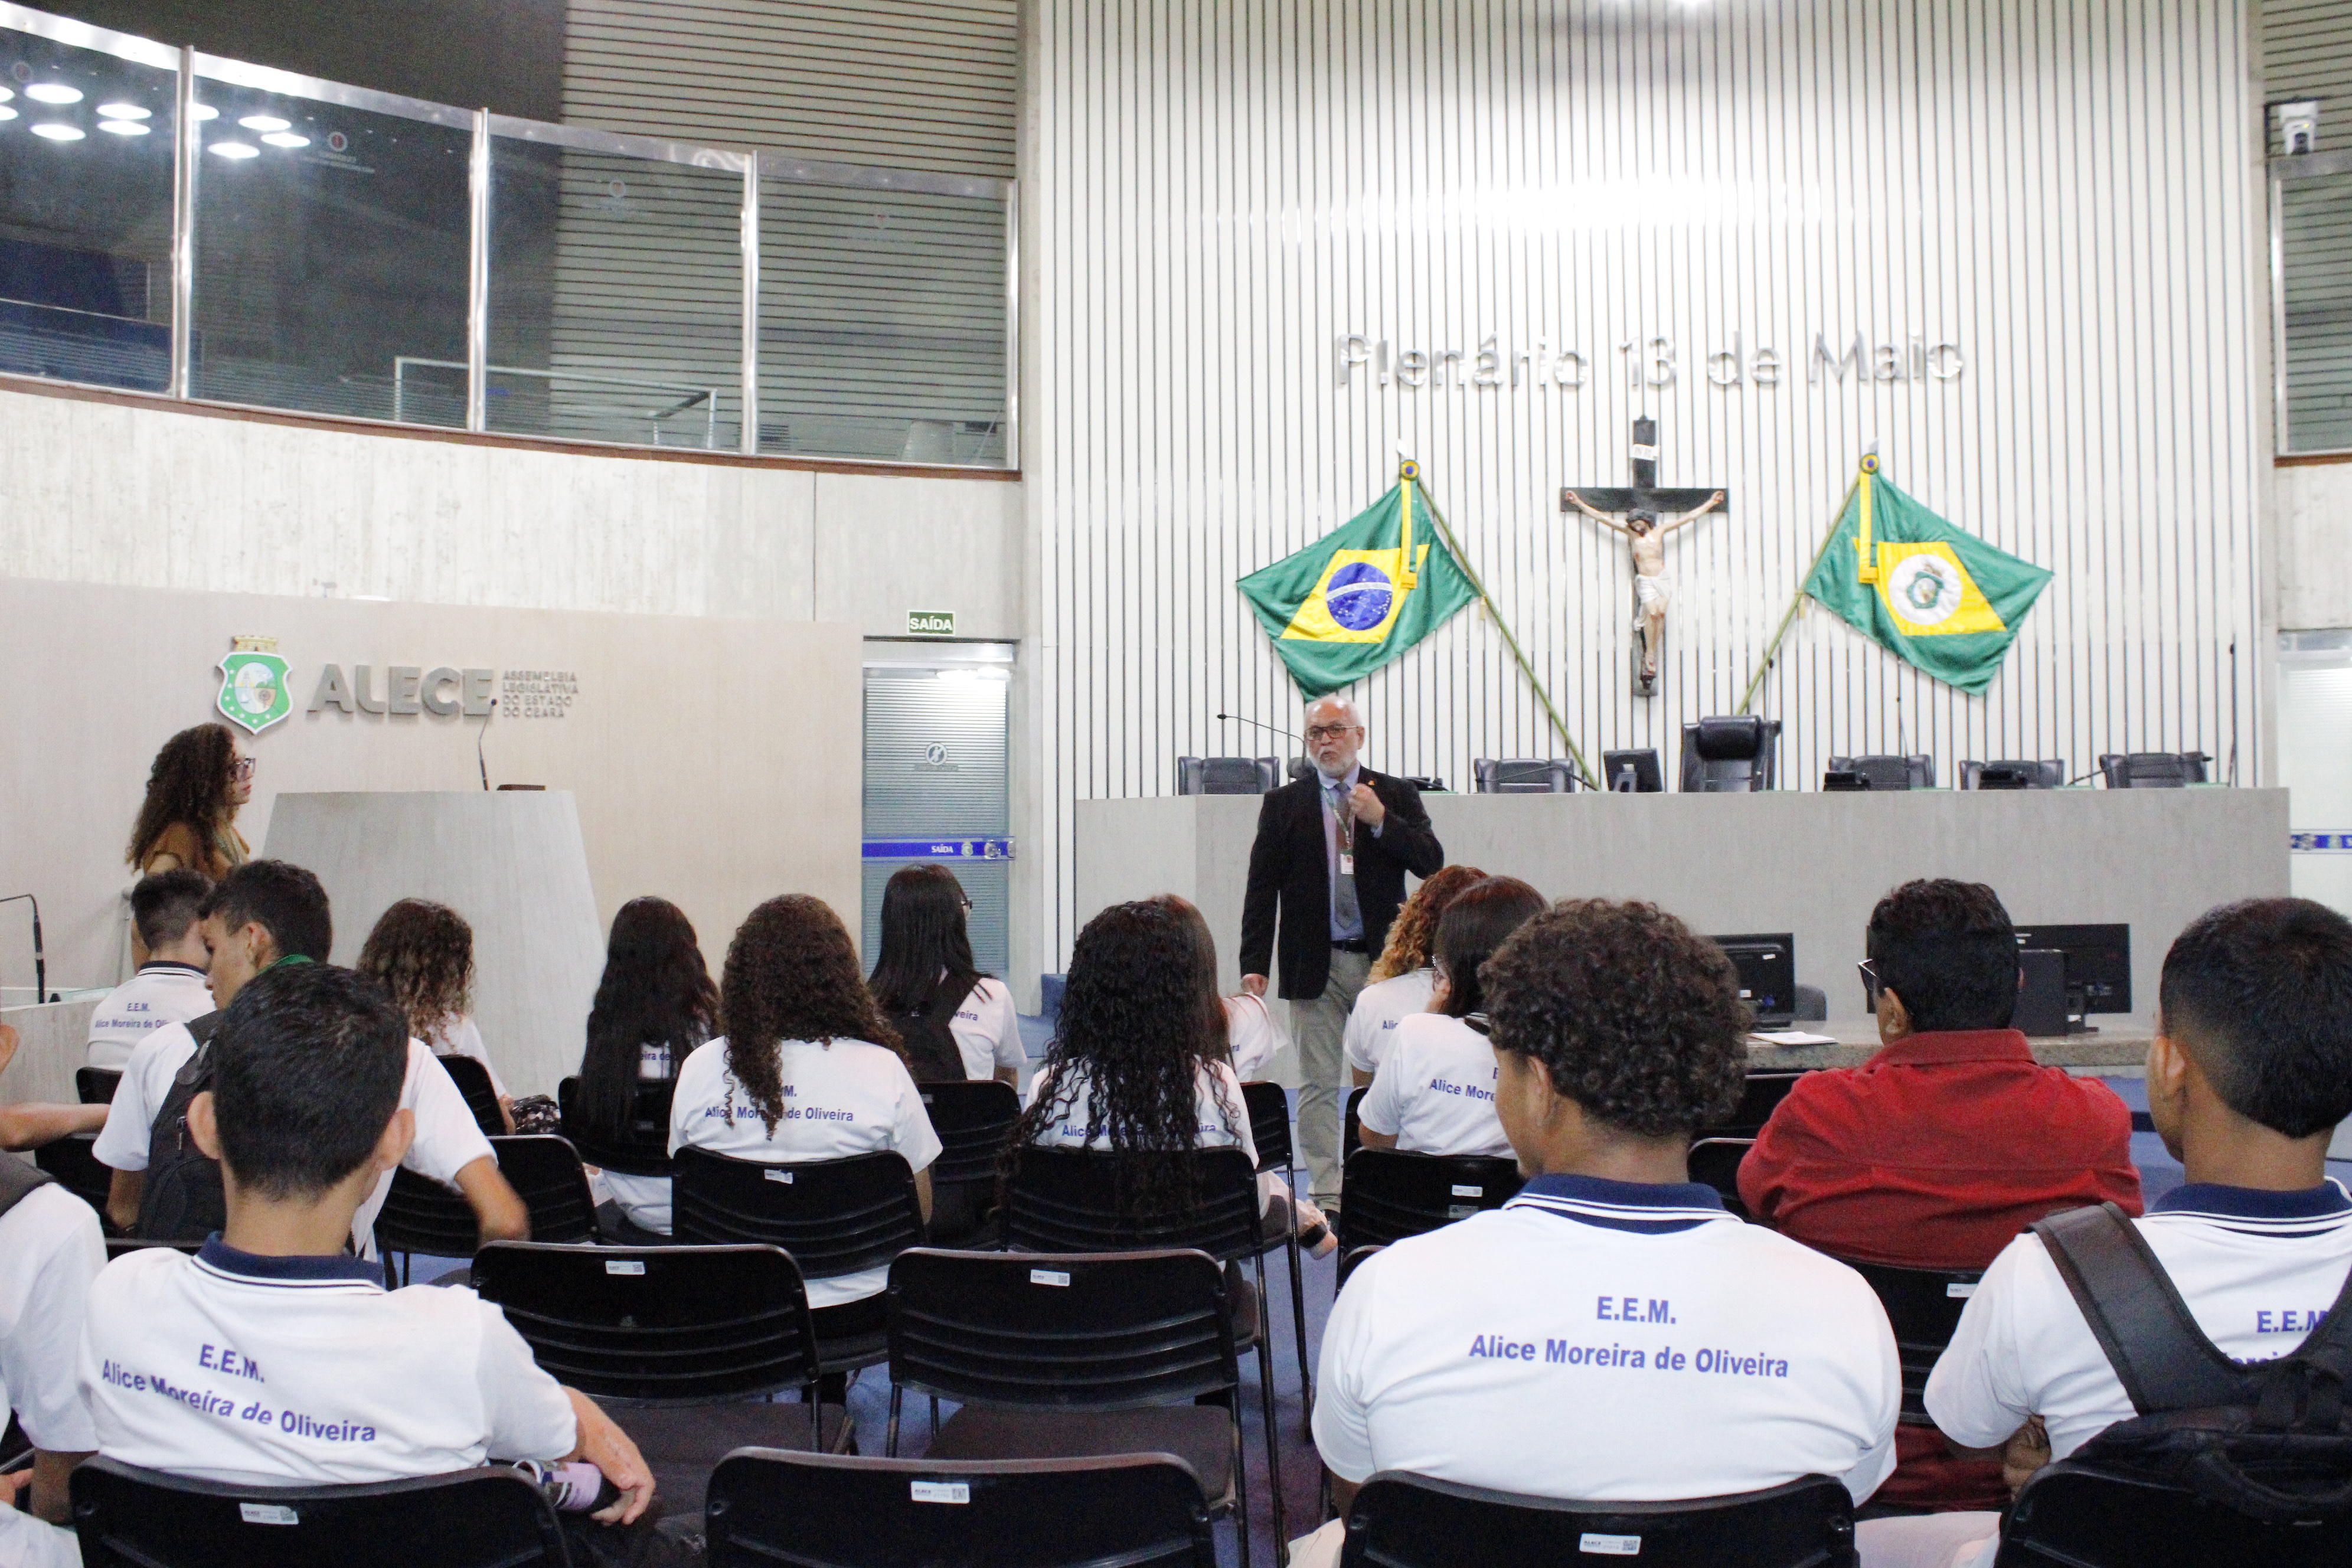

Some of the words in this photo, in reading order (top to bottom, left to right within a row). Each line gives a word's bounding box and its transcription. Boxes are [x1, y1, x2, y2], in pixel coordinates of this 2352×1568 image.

[1335, 329, 1588, 387] Plenário
[1619, 334, 1676, 387] 13
[1707, 329, 1781, 386] de
[1809, 328, 1963, 385] Maio
[910, 616, 953, 631] SAÍDA
[307, 664, 495, 716] ALECE
[502, 682, 579, 693] LEGISLATIVA
[503, 694, 520, 705] DO
[525, 695, 572, 706] ESTADO
[503, 707, 520, 717] DO
[931, 844, 953, 852] SAÍDA
[127, 1003, 150, 1011] E.E.M.
[95, 1020, 109, 1028] Alice
[112, 1019, 141, 1028] Moreira
[143, 1020, 153, 1028] de
[1429, 1079, 1461, 1095] Alice
[788, 1108, 801, 1119] de
[806, 1108, 853, 1121] Oliveira
[1597, 1296, 1677, 1324] E.E.M.
[198, 1344, 265, 1383] E.E.M.
[1469, 1335, 1536, 1360] Alice
[1545, 1339, 1645, 1368] Moreira
[1655, 1347, 1686, 1371] de
[1696, 1348, 1788, 1377] Oliveira
[102, 1359, 146, 1391] Alice
[151, 1376, 234, 1417] Moreira
[241, 1402, 273, 1425] de
[280, 1410, 376, 1442] Oliveira
